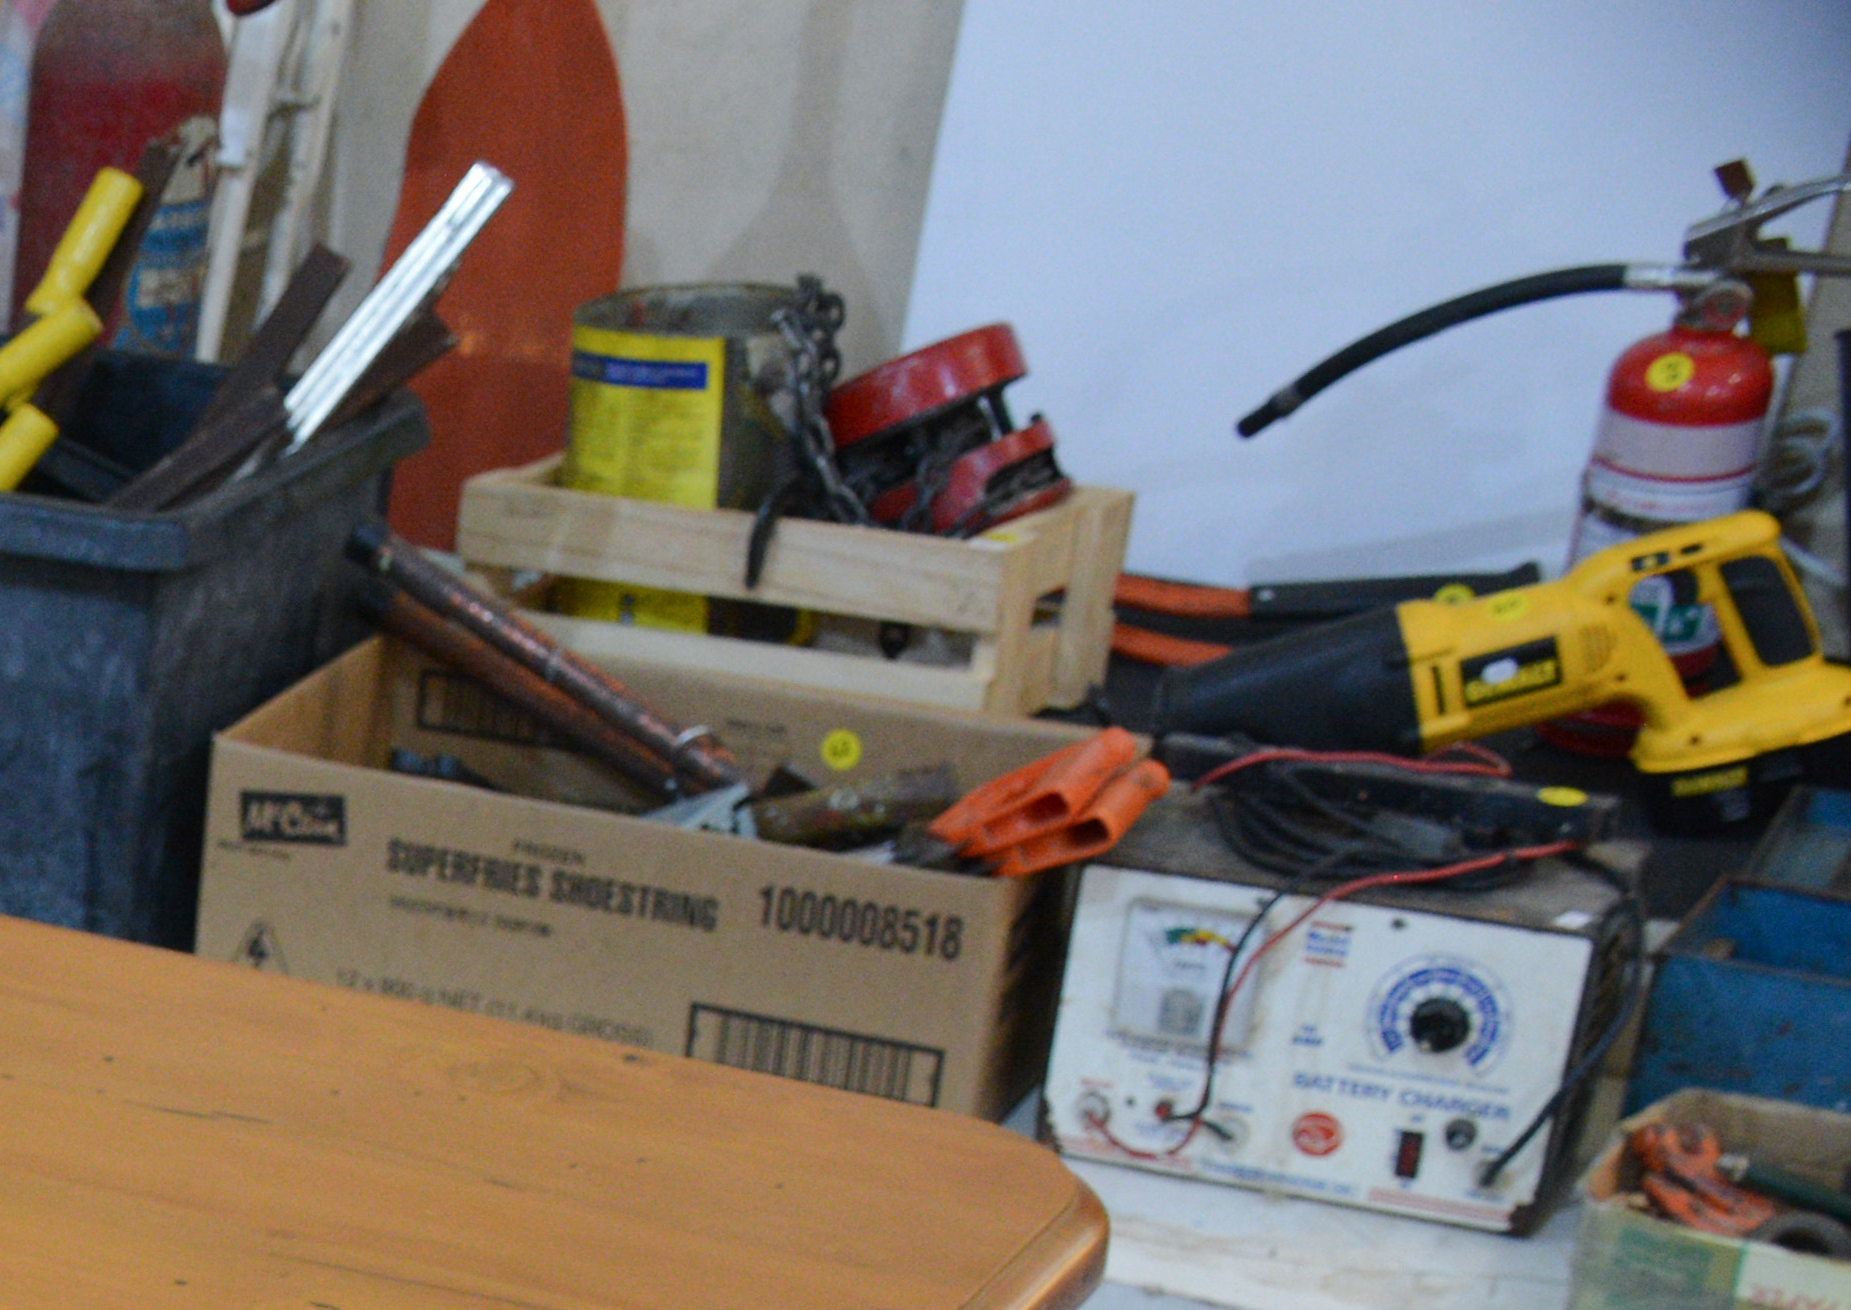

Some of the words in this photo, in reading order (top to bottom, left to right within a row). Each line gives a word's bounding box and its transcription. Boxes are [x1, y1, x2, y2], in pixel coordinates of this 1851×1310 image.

[385, 836, 544, 899] SUPERFRIES
[548, 866, 721, 933] SHOESTRING
[758, 883, 966, 962] 1000008518
[1292, 1071, 1393, 1103] BATTERY
[1397, 1086, 1511, 1121] CHARGER
